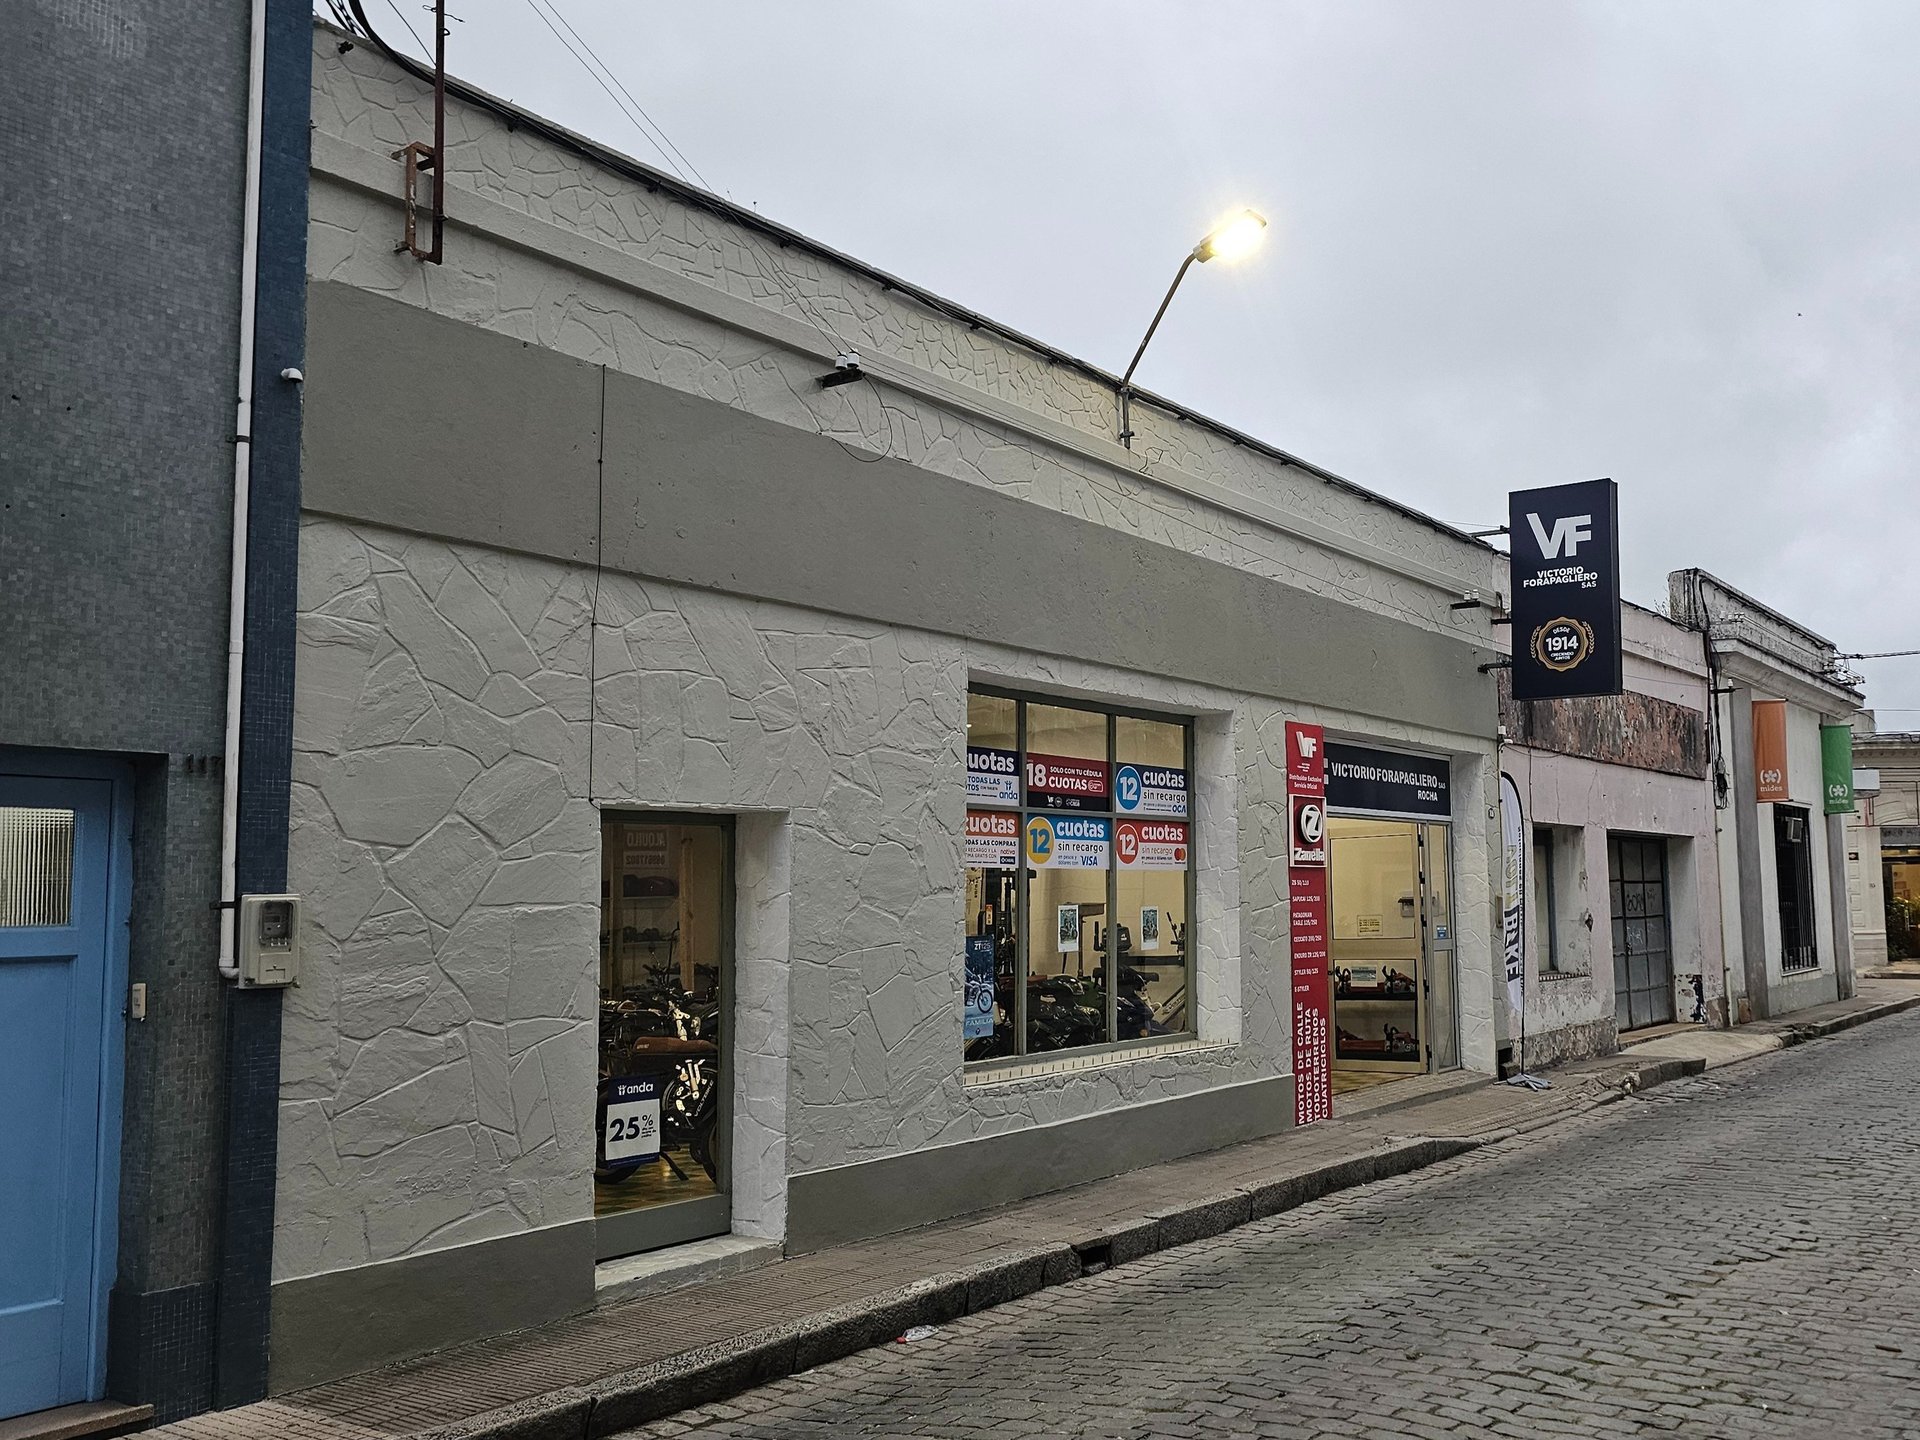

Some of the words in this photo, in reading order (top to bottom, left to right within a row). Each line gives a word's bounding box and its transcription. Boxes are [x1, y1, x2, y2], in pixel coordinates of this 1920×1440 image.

[1526, 513, 1592, 560] VF
[1523, 572, 1598, 588] FORAPAGLIERO
[1537, 566, 1584, 579] VICTORIO
[1581, 581, 1597, 589] SAS
[1545, 635, 1579, 652] 1914
[1296, 731, 1317, 758] VF
[966, 751, 1015, 773] uotas
[1026, 762, 1047, 788] 18
[1049, 765, 1064, 774] SOLO
[1064, 767, 1076, 775] CON
[1076, 768, 1083, 776] TU
[1082, 768, 1103, 778] CÉDULA
[1142, 770, 1185, 788] cuotas
[1331, 761, 1376, 781] VICTORIO
[1376, 768, 1438, 789] FORAPAGLIERO
[968, 775, 988, 785] TODAS
[988, 777, 1001, 786] LAS
[1048, 776, 1088, 791] CUOTAS
[1120, 776, 1138, 801] 12
[1760, 784, 1783, 792] mides
[999, 790, 1018, 800] anda
[1143, 790, 1155, 800] sin
[1156, 791, 1186, 804] recargo
[1417, 789, 1438, 801] ROCHA
[1056, 820, 1105, 838] cuotas
[1141, 824, 1184, 841] cuotas
[1029, 828, 1051, 854] 12
[1057, 841, 1070, 851] sin
[1073, 843, 1104, 854] recargo
[1119, 833, 1136, 856] 12
[1141, 845, 1151, 854] sin
[1151, 846, 1173, 856] recargo
[1294, 847, 1325, 862] Zanella
[1080, 855, 1098, 866] VISA
[1296, 1002, 1304, 1046] CALLE
[1304, 1007, 1312, 1045] RUTA
[1297, 1049, 1304, 1069] DE
[1305, 1048, 1312, 1068] DE
[1312, 1007, 1321, 1121] TODOTERRENOS
[1319, 1017, 1329, 1119] CUATRICICLOS
[626, 1081, 654, 1095] anda
[1305, 1071, 1313, 1122] MOTOS
